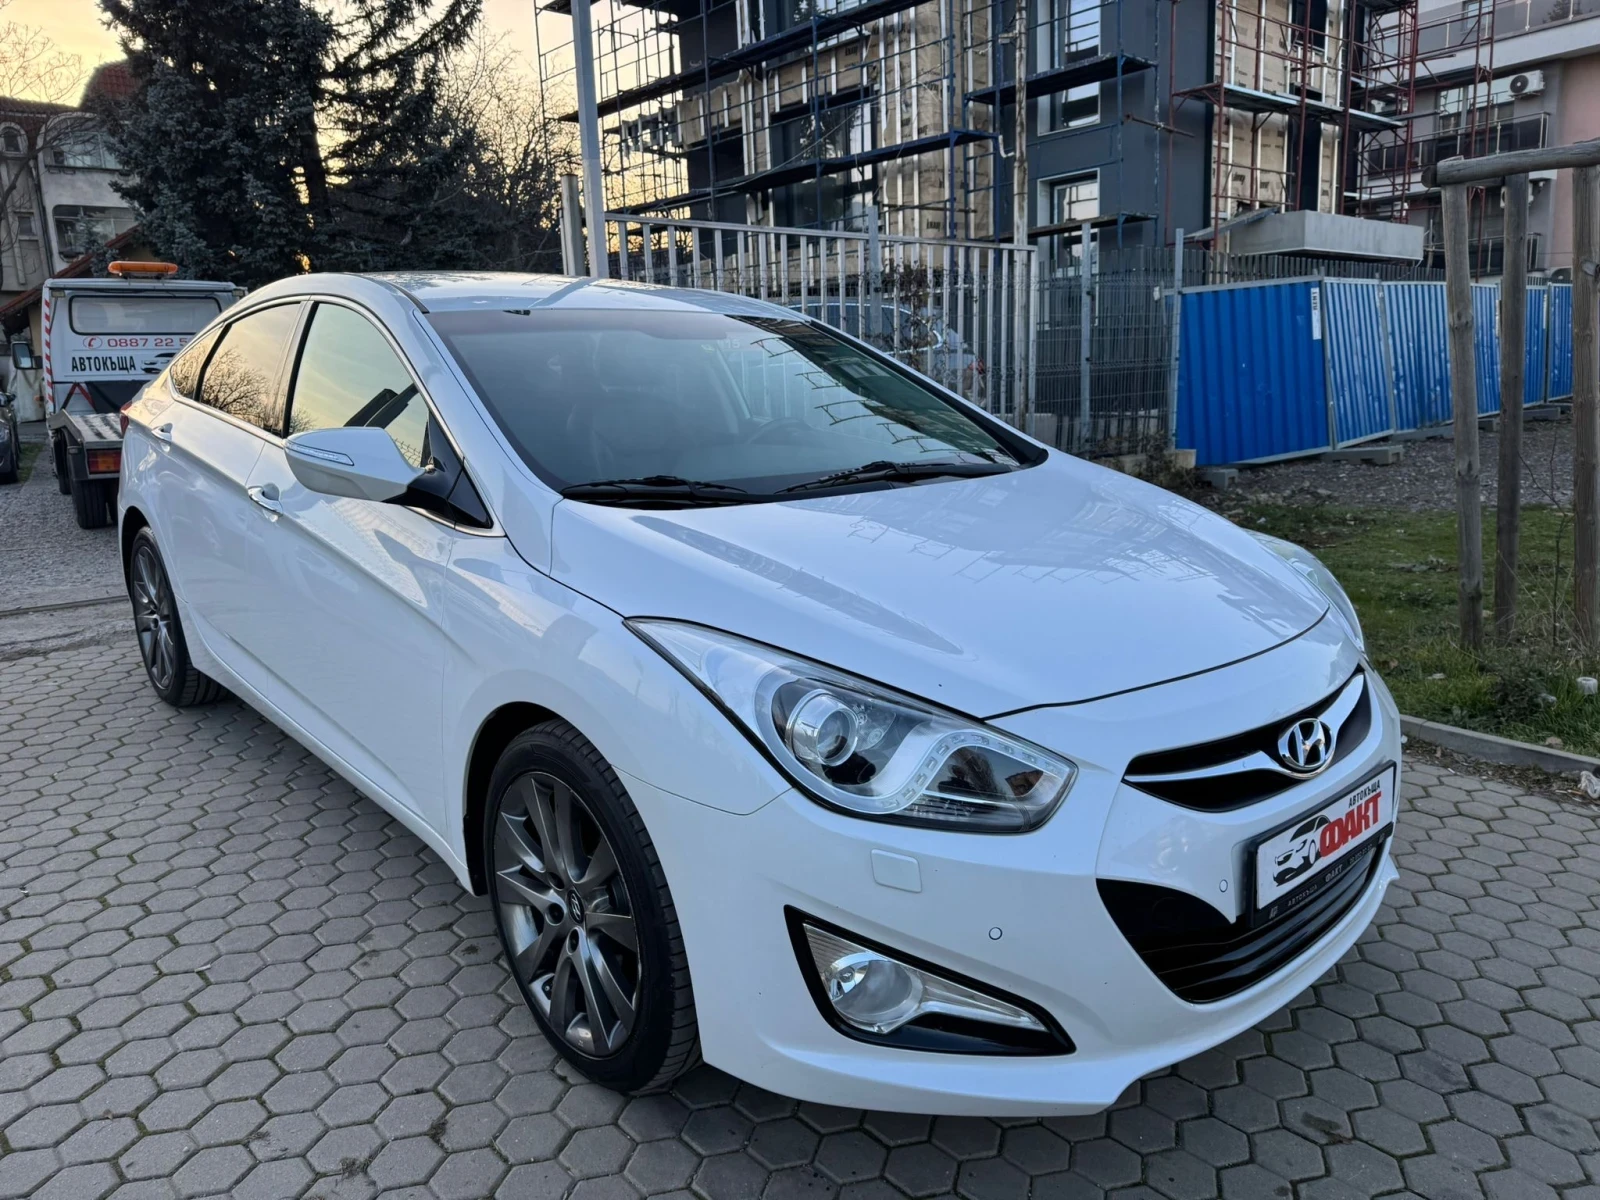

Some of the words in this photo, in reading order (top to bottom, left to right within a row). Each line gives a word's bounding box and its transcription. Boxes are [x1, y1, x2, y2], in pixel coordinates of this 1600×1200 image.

[107, 337, 148, 348] 0887
[154, 337, 174, 347] 22
[71, 356, 137, 374] АВТОКЪЩА
[1348, 779, 1381, 808] АВТОКЪЩА
[1319, 791, 1382, 858] ФАКТ
[1325, 864, 1343, 883] ФАКТ
